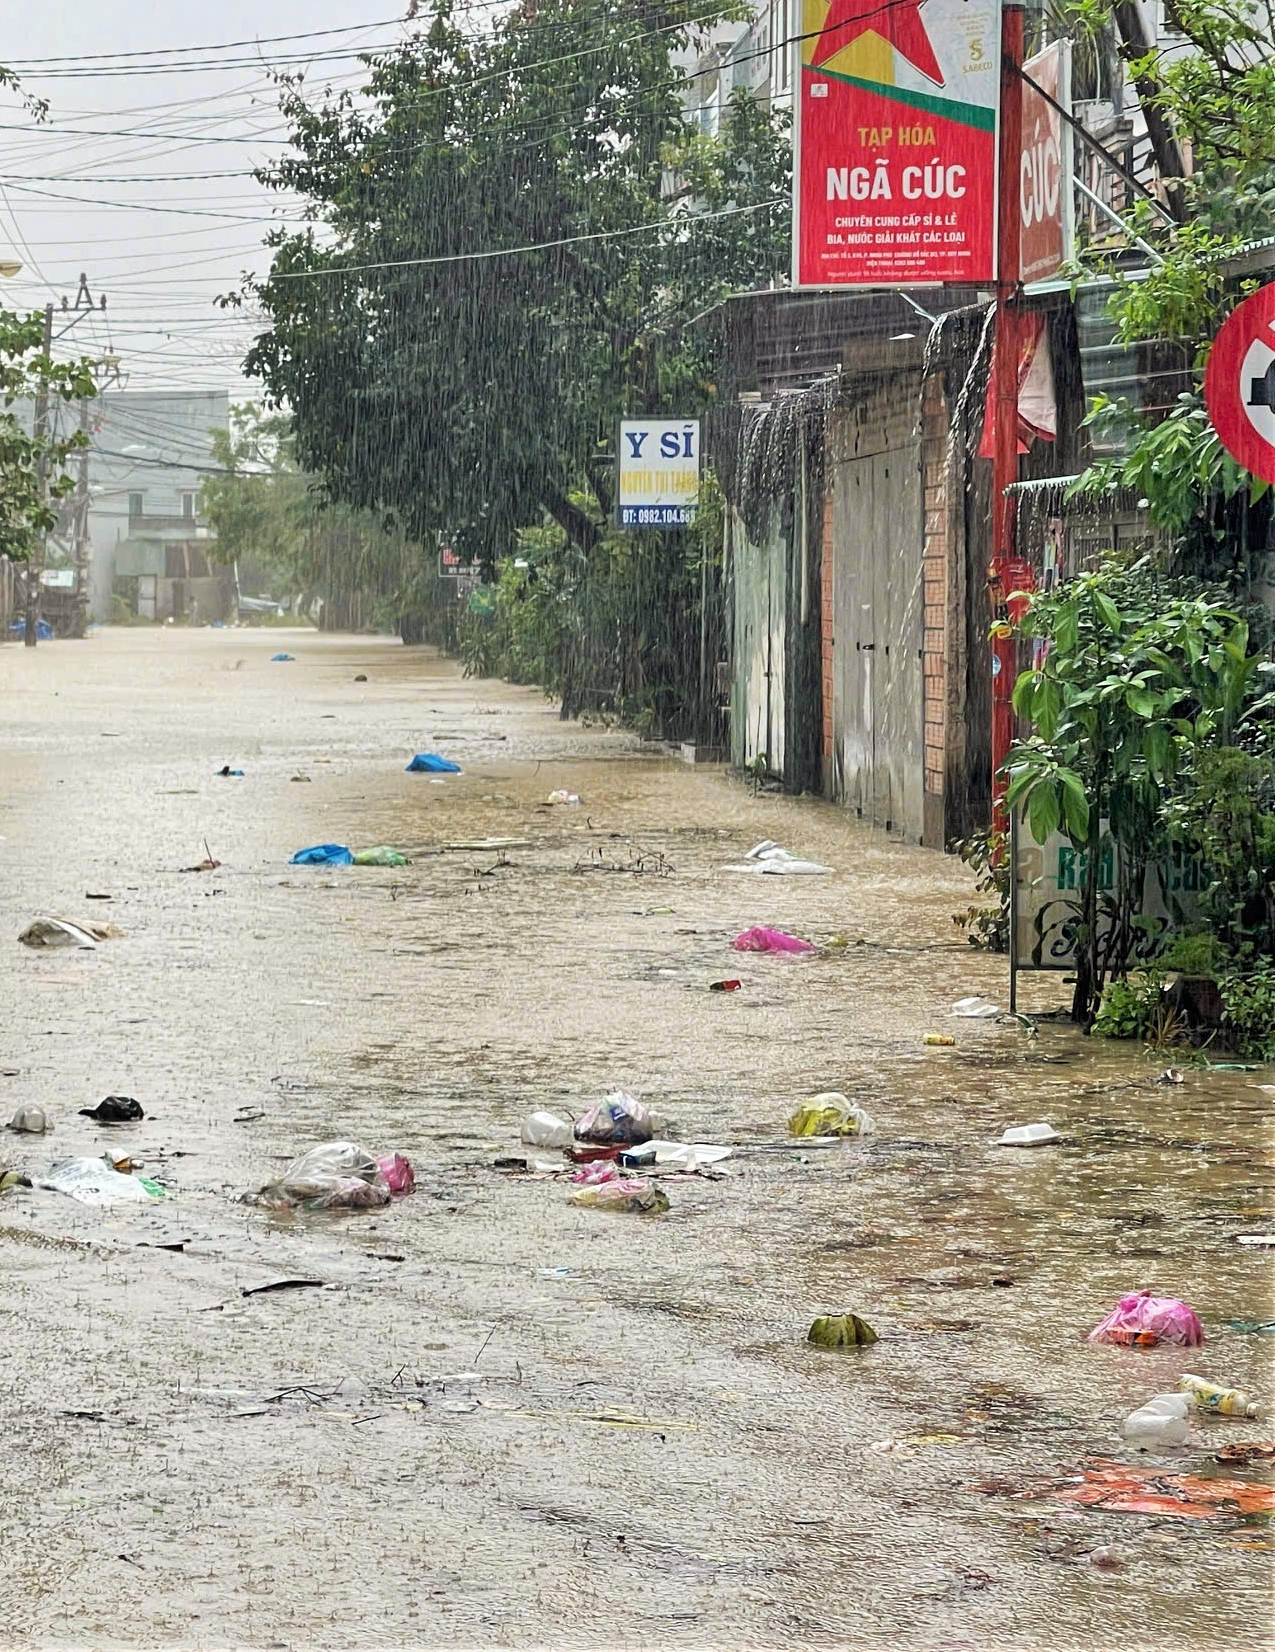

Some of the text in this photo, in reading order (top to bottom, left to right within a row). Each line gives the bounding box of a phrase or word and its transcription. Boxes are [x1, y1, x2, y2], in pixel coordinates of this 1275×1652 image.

[858, 122, 936, 153] TẠP HÓA
[826, 157, 967, 201] NGÃ CÚC
[1020, 117, 1062, 228] CÚC
[835, 214, 873, 228] CHUYÊN
[874, 216, 901, 227] CUNG
[902, 212, 921, 227] CẤP
[935, 215, 943, 226] &
[827, 234, 846, 245] BIA,
[847, 232, 873, 244] NƯỚC
[896, 230, 921, 243] KHÁT
[923, 230, 942, 243] CÁC
[943, 231, 965, 245] LOẠI
[625, 424, 694, 458] Y SĨ
